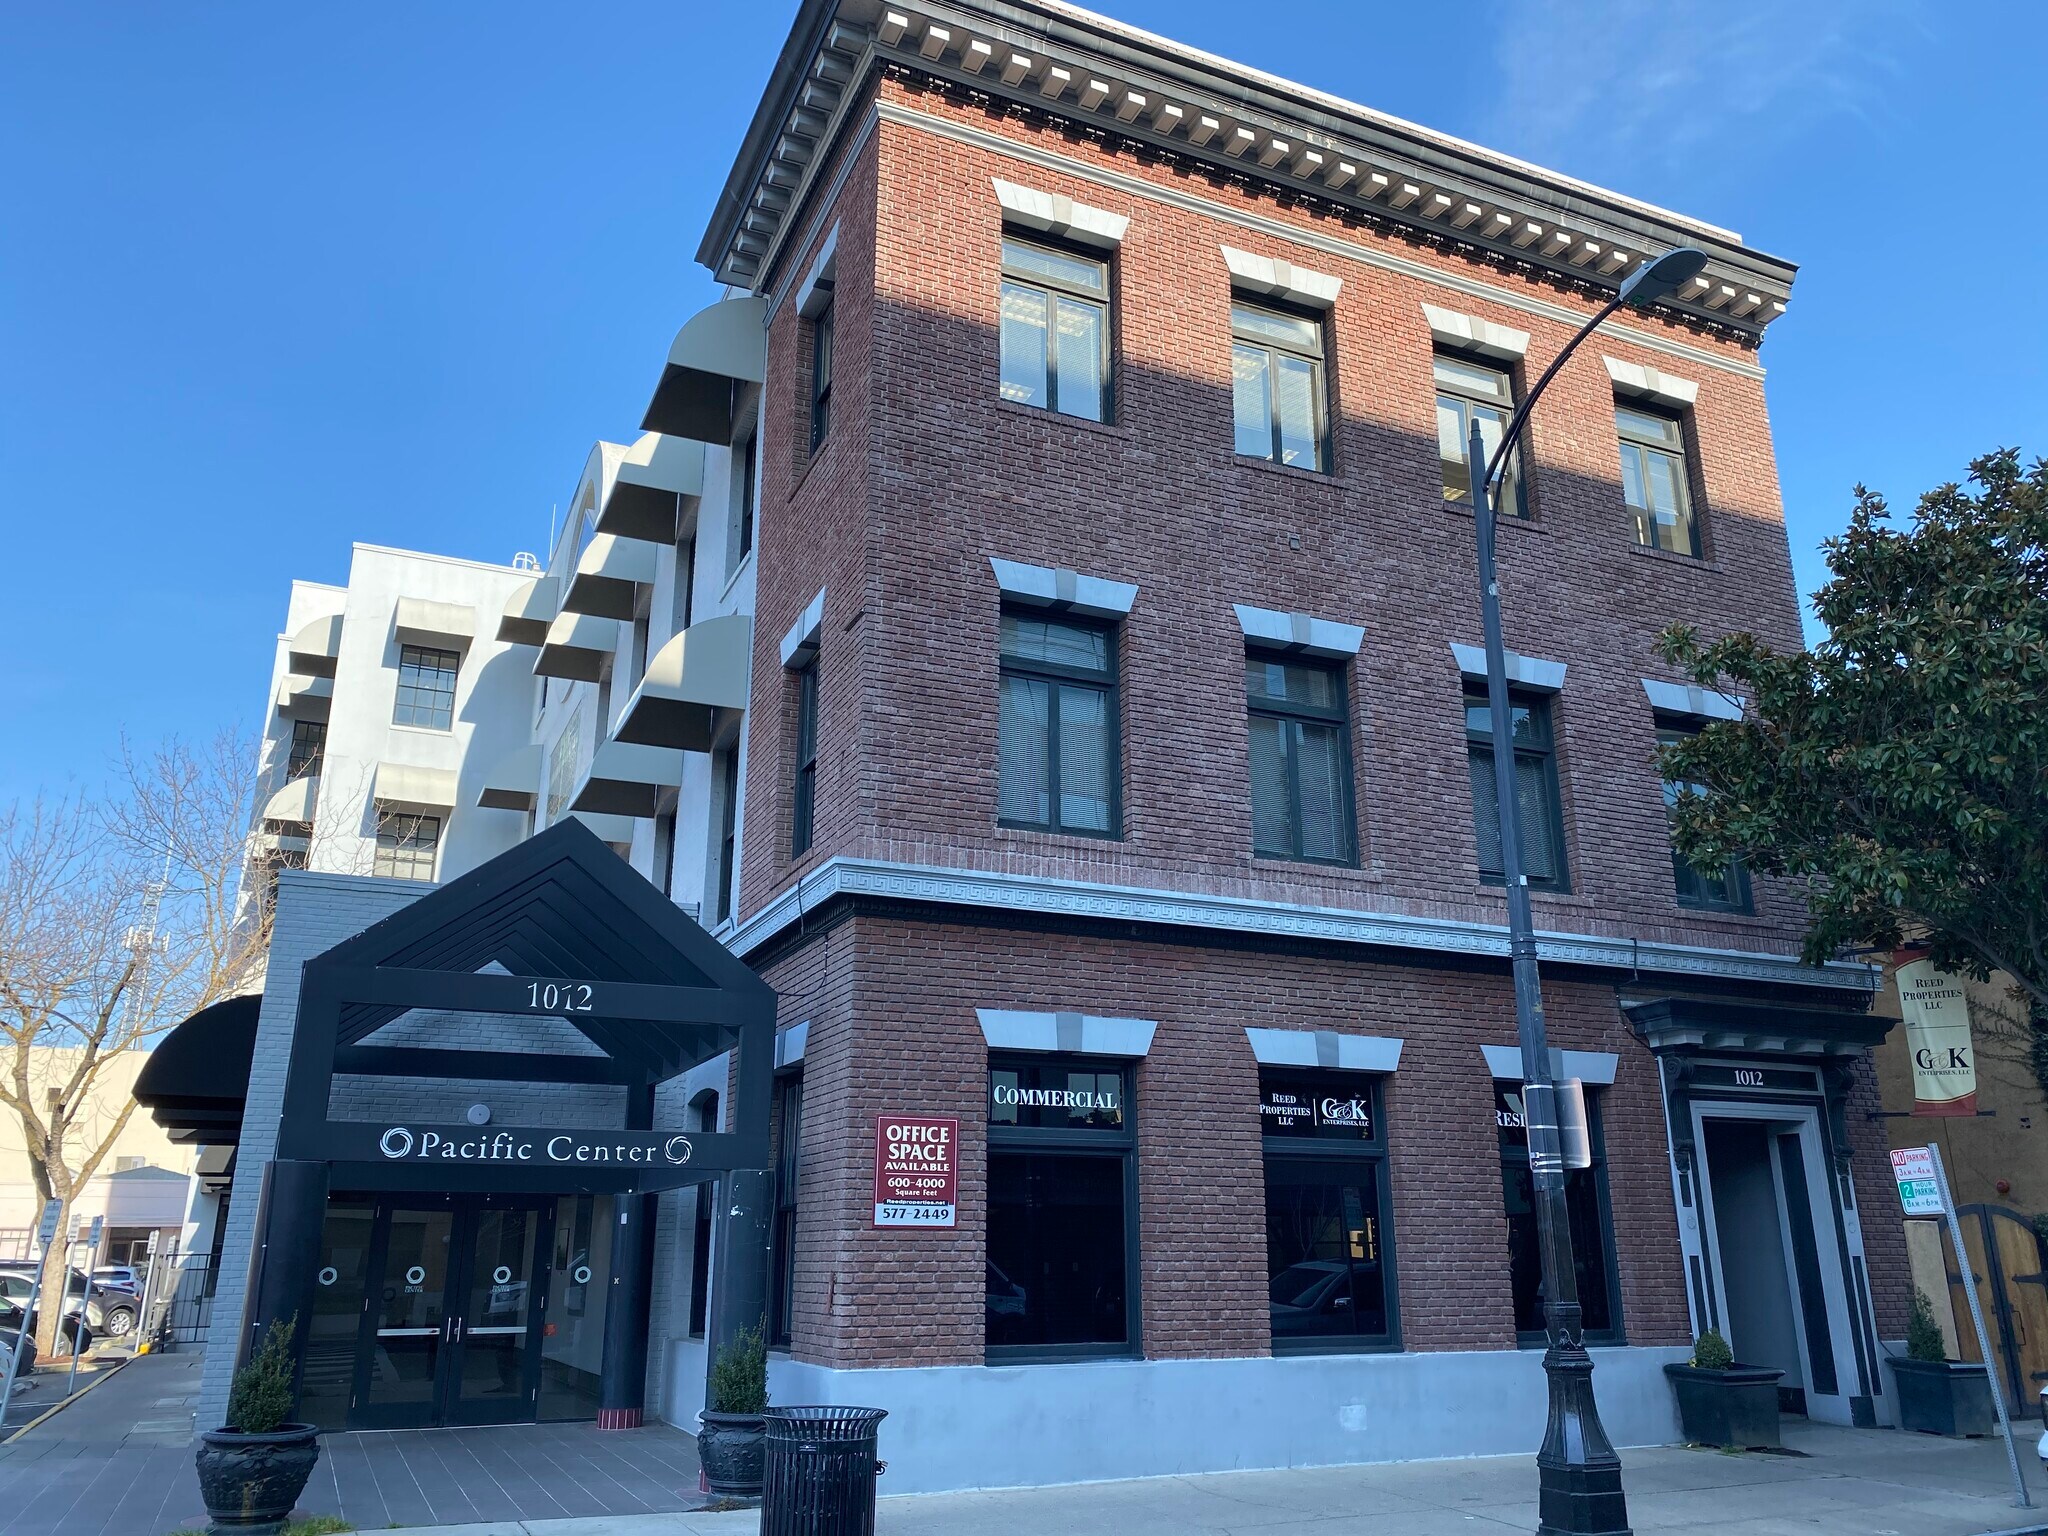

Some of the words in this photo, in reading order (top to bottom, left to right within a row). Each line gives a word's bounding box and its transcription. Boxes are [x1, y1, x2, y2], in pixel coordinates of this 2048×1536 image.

[1916, 978, 1944, 988] REED
[527, 982, 592, 1011] 1012
[1902, 989, 1962, 1000] PROPERTIES
[1924, 1001, 1942, 1010] LLC
[1734, 1070, 1764, 1086] 1012
[994, 1085, 1117, 1108] COMMERCIAL
[1272, 1092, 1296, 1104] REED
[1260, 1104, 1310, 1116] PROPERTIES
[1278, 1116, 1294, 1126] LLC
[886, 1125, 950, 1142] OFFICE
[417, 1132, 532, 1160] Pacific
[546, 1136, 656, 1162] Center
[888, 1143, 946, 1160] SPACE
[1892, 1152, 1905, 1165] NO
[1906, 1153, 1928, 1162] PARKING
[884, 1162, 950, 1172] AVAILABLE
[888, 1178, 946, 1188] 600-4000
[895, 1188, 920, 1196] Square
[1904, 1185, 1912, 1197] 2
[1915, 1187, 1937, 1196] PARKING
[883, 1208, 949, 1220] 577-2449
